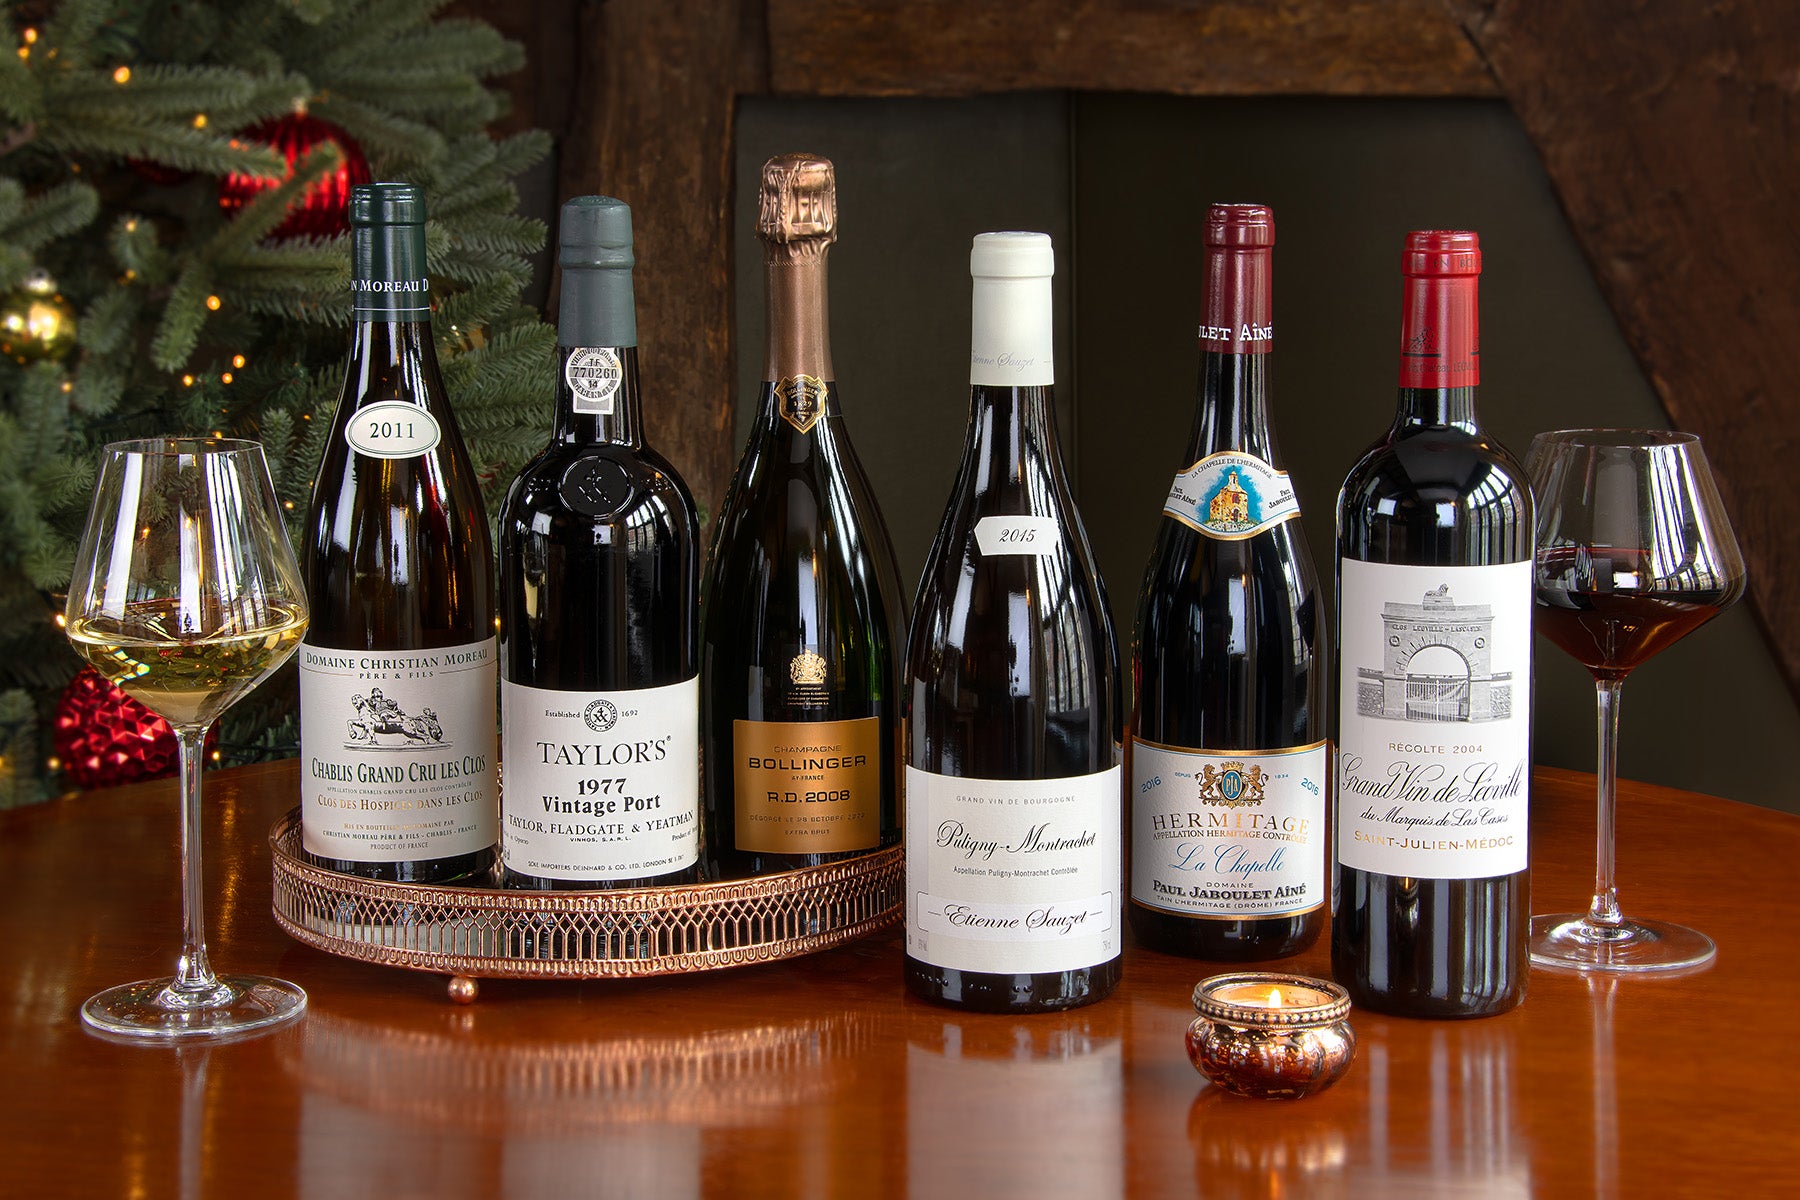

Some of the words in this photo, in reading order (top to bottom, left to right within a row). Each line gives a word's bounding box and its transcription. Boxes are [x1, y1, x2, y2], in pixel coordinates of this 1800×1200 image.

[360, 279, 420, 292] MOREAU
[573, 367, 617, 379] 770260
[369, 422, 415, 440] 2011
[999, 528, 1036, 543] 2015
[306, 652, 355, 669] DOMAINE
[359, 656, 438, 670] CHRISTIAN
[444, 649, 487, 666] MOREAU
[359, 671, 387, 679] PÈRE
[545, 710, 581, 719] Established
[774, 745, 841, 753] CHAMPAGNE
[1388, 742, 1445, 754] RÉCOLTE
[1452, 744, 1483, 754] 2004
[312, 757, 353, 783] CHABLIS
[357, 763, 404, 784] GRAND
[408, 762, 436, 783] CRU
[440, 760, 460, 779] LES
[462, 754, 486, 776] CLOS
[749, 755, 867, 770] BOLLINGER
[1141, 776, 1162, 794] 2016
[1300, 778, 1320, 796] 2016
[1342, 752, 1396, 799] Grand
[1387, 760, 1446, 801] Vin
[1432, 775, 1460, 803] de
[578, 778, 627, 796] 1977
[317, 794, 337, 808] CLOS
[340, 799, 357, 810] DES
[360, 799, 413, 811] HOSPICES
[416, 798, 443, 810] DANS
[446, 795, 461, 806] LES
[463, 789, 483, 803] CLOS
[542, 796, 616, 817] Vintage
[624, 794, 661, 813] Port
[767, 792, 802, 803] R.D.
[805, 790, 850, 802] 2008
[956, 795, 984, 804] GRAND
[1024, 795, 1076, 805] BOURGOGNE
[508, 814, 547, 834] TAYLOR,
[550, 824, 624, 835] FLADGATE
[631, 824, 640, 833] &
[646, 810, 694, 831] YEATMAN
[1152, 812, 1310, 836] HERMITAGE
[1360, 806, 1378, 820] du
[1377, 806, 1436, 831] Marquis
[1434, 812, 1451, 827] de
[1450, 808, 1478, 827] Las
[1478, 807, 1509, 826] Cases
[352, 832, 378, 840] MOREAU
[1153, 830, 1205, 840] APPELLATION
[1206, 830, 1260, 839] HERMITAGE
[1354, 830, 1514, 850] SAINT-JULIEN-MÉDOC
[1168, 842, 1206, 872] La
[1214, 844, 1287, 880] Chapelle
[954, 865, 986, 876] Appellation
[988, 868, 1050, 878] Puligny-Montrachet
[1153, 880, 1186, 897] PAUL
[1189, 887, 1272, 901] JABOULET
[1274, 882, 1307, 899] AÎNÉ
[1156, 895, 1172, 903] TAIN
[1274, 898, 1303, 907] FRANCE
[943, 904, 1019, 928] Etienne
[1025, 906, 1087, 935] Sauzet
